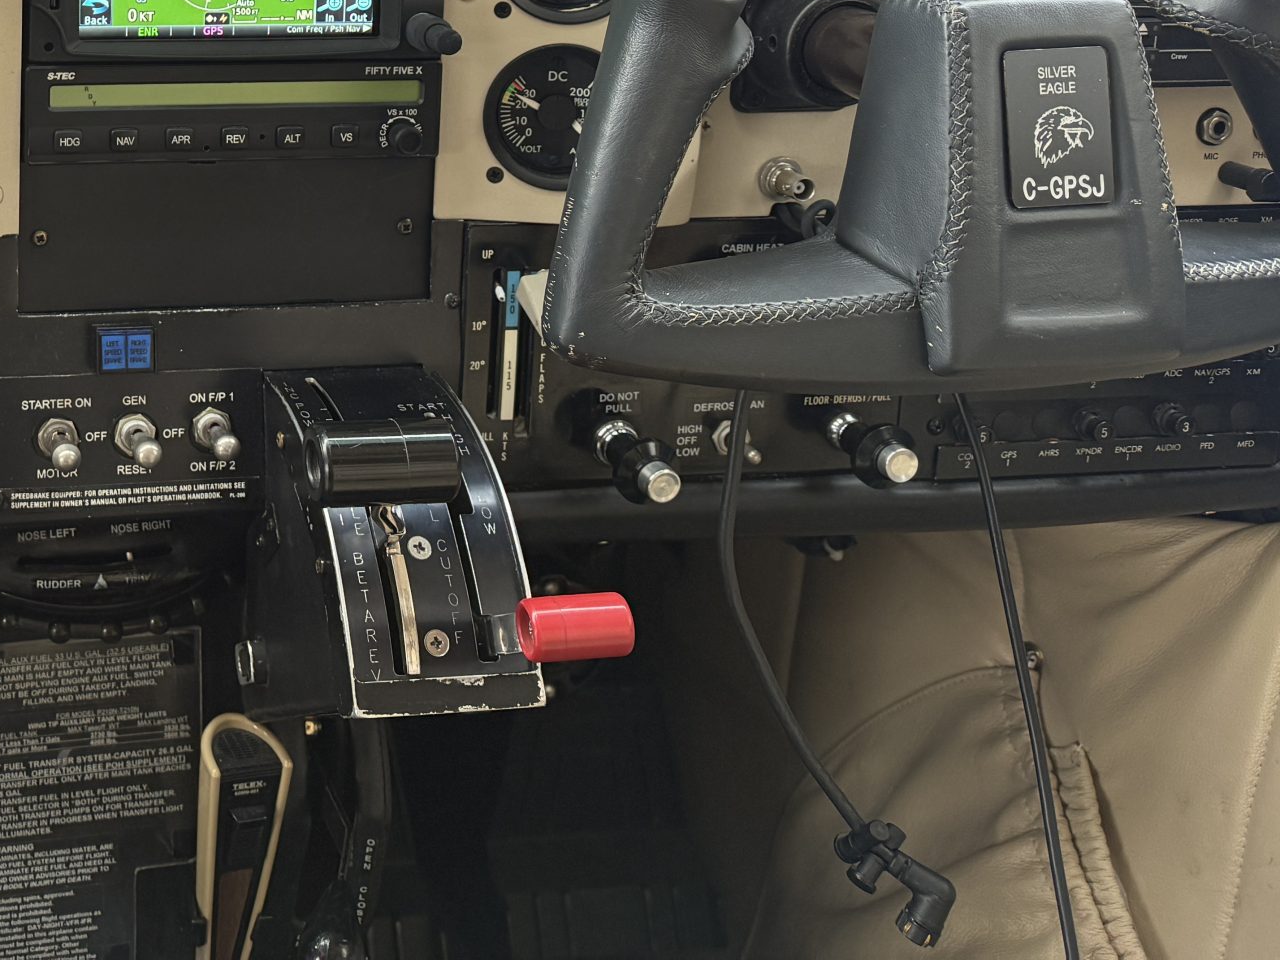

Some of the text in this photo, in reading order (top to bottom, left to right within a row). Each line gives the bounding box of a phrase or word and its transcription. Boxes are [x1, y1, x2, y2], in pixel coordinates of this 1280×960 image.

[365, 66, 423, 75] FIFTY FIVE X
[1037, 65, 1076, 79] SILVER
[47, 72, 75, 80] S-TEC
[548, 71, 568, 82] DC
[1039, 81, 1076, 95] EAGLE
[60, 137, 80, 147] HDG
[116, 136, 135, 146] NAV
[171, 135, 190, 145] APR
[226, 134, 246, 144] REV
[1023, 174, 1106, 200] C-GPSJ
[1194, 367, 1231, 377] NAV/GPS
[122, 396, 146, 405] GEN
[599, 391, 640, 403] DO NOT
[22, 398, 91, 410] STARTER ON
[605, 402, 632, 413] PULL
[85, 432, 107, 441] OFF
[163, 429, 185, 438] OFF
[1156, 443, 1181, 452] AUDIO
[36, 578, 82, 590] RUDDER
